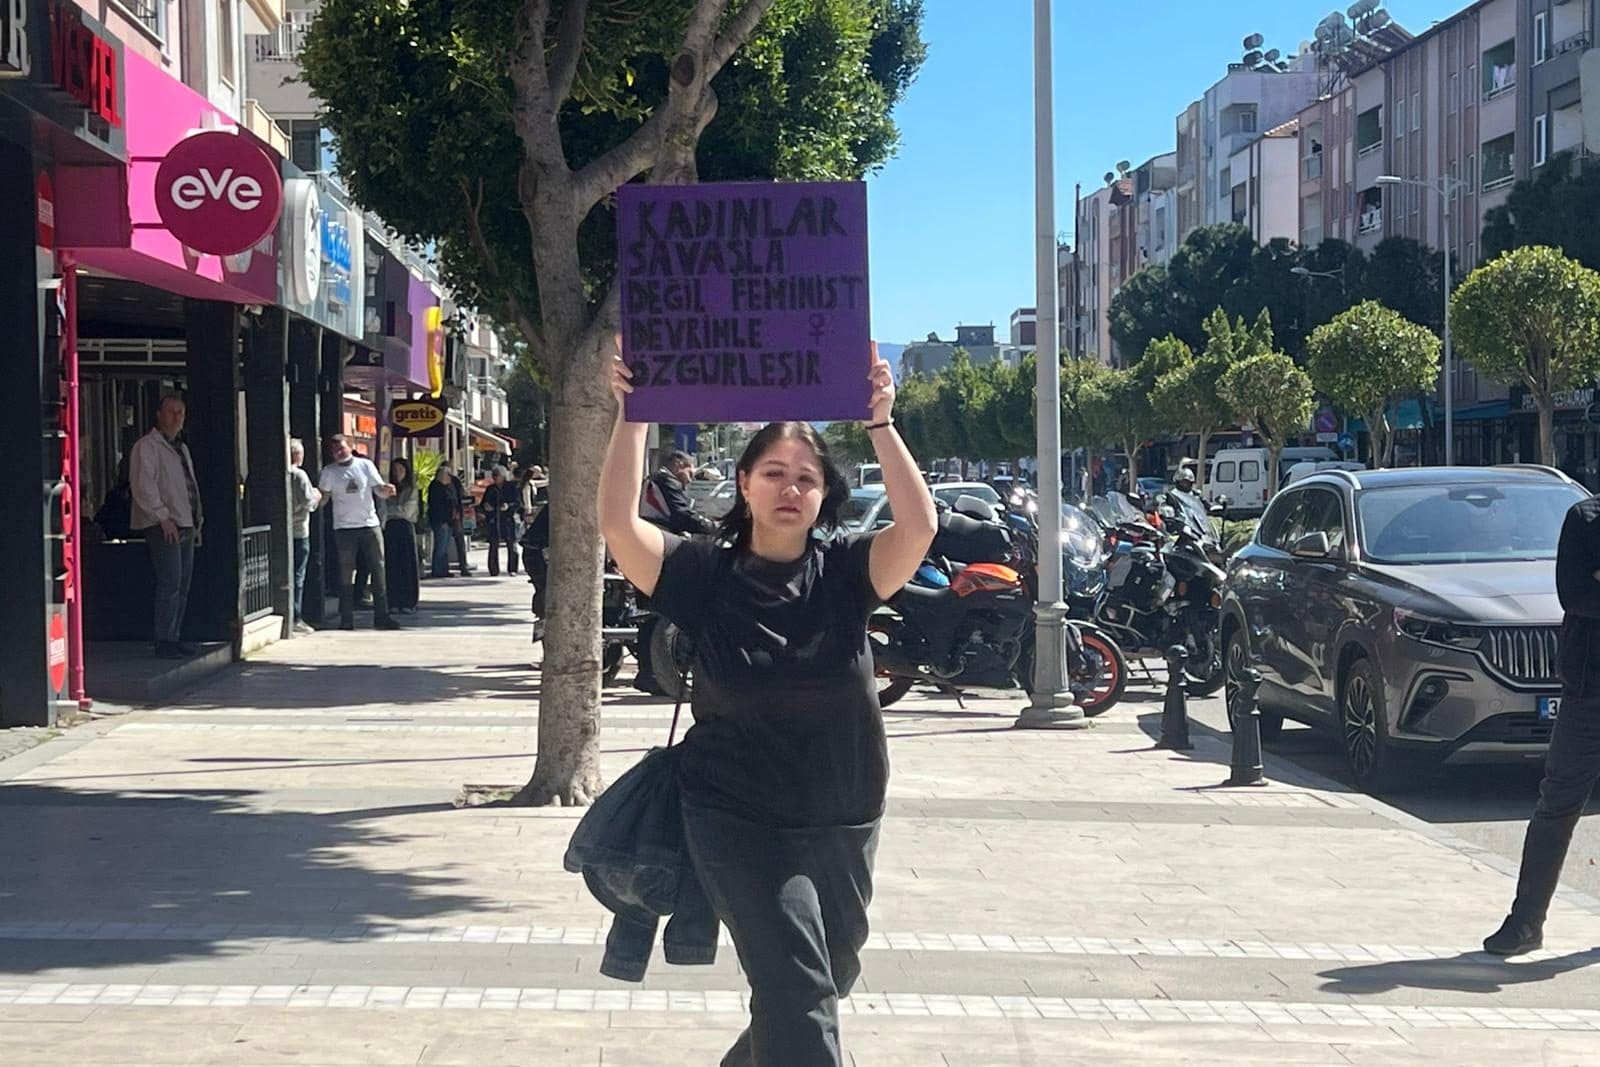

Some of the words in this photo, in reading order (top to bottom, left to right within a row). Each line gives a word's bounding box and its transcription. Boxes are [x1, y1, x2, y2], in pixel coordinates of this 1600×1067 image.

[171, 168, 262, 210] eve
[638, 197, 848, 241] KADINLAR
[395, 406, 437, 422] gratis
